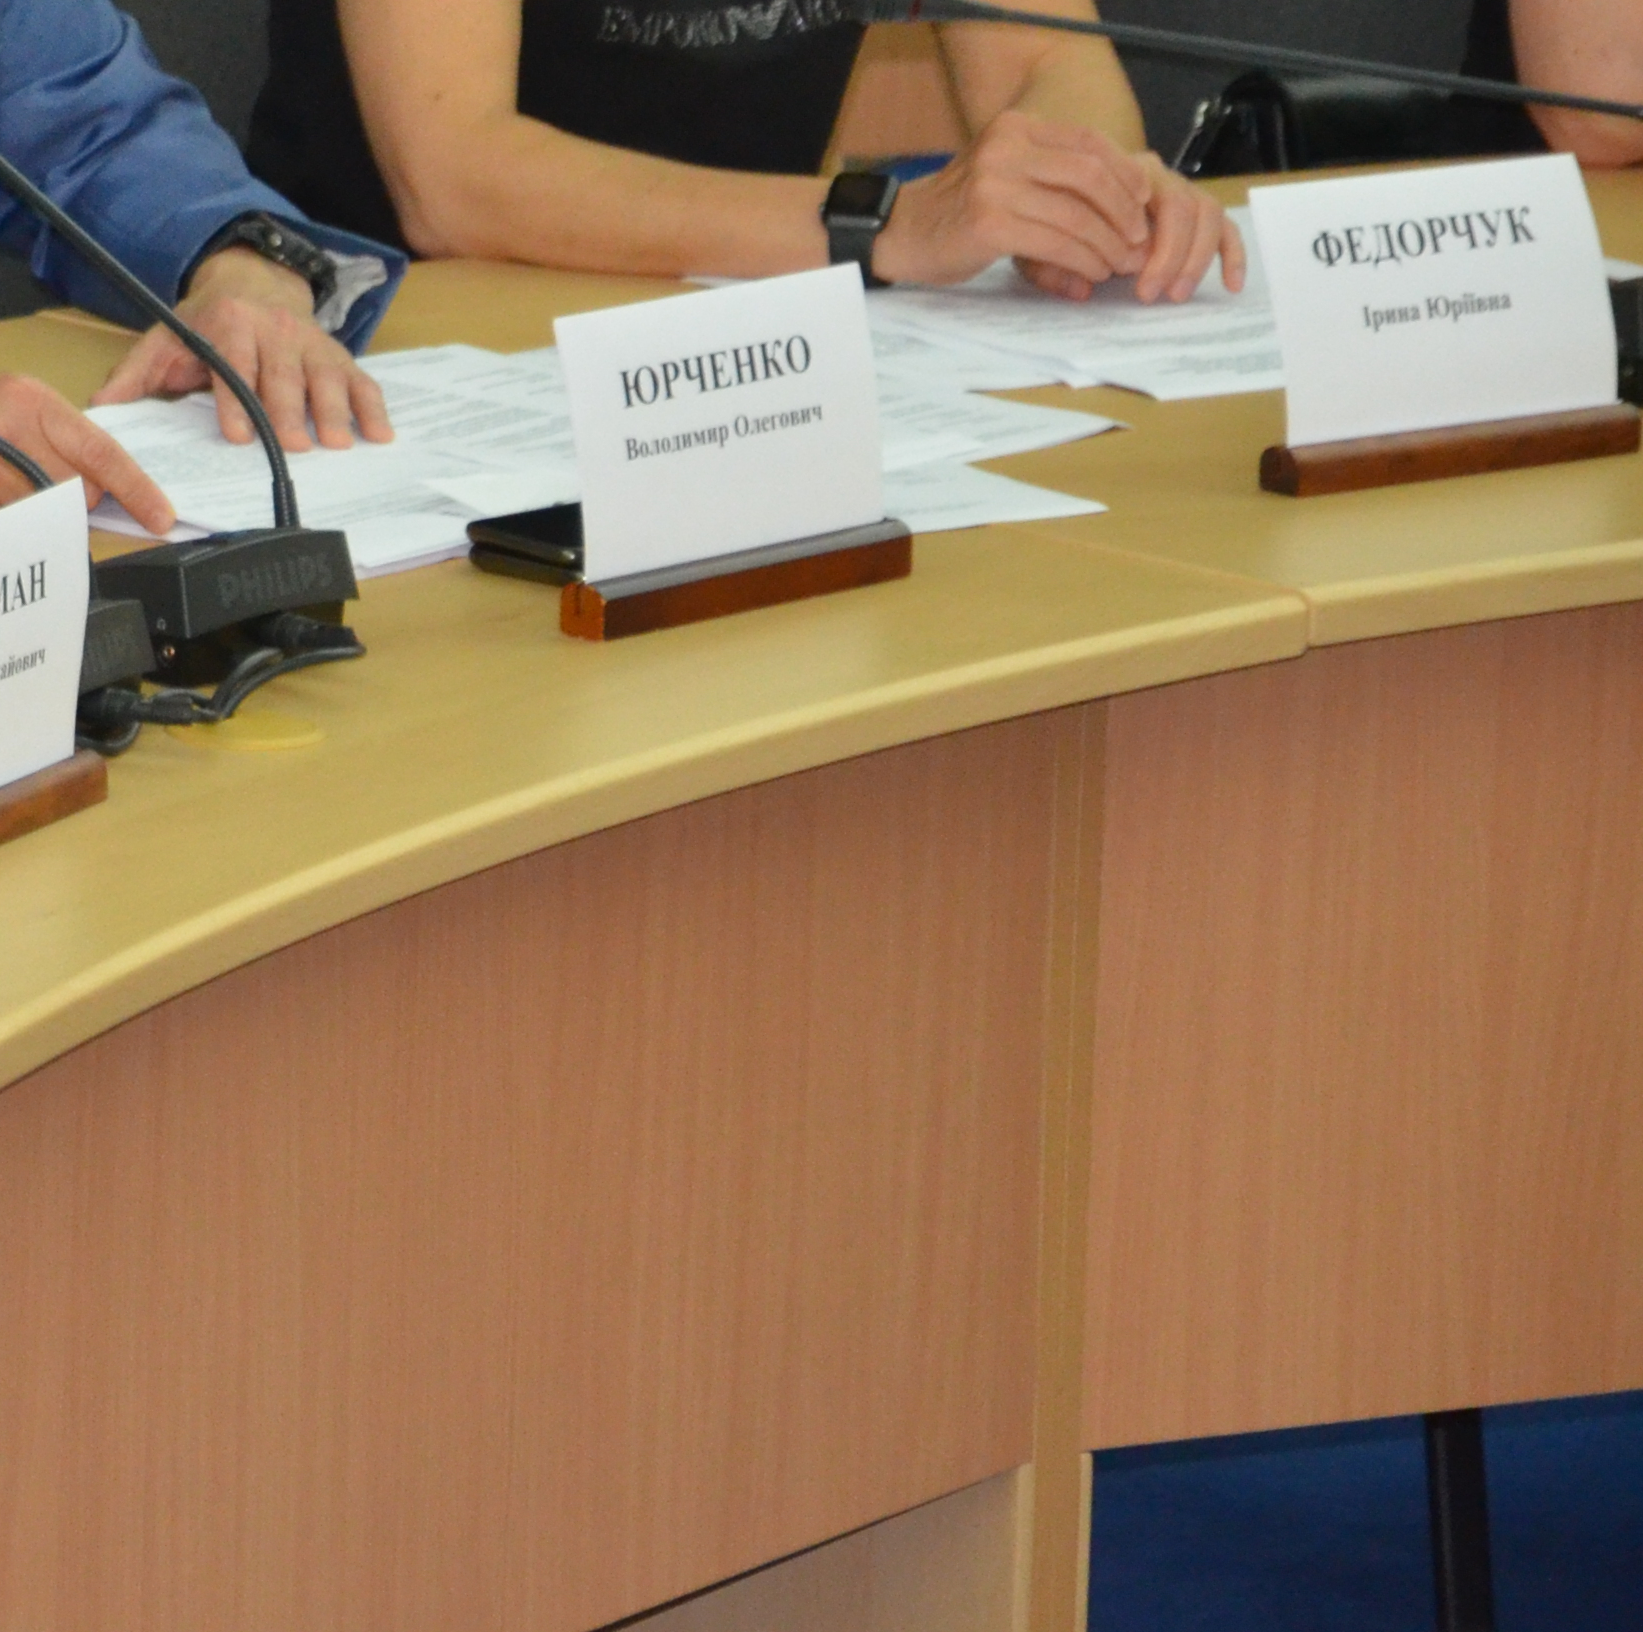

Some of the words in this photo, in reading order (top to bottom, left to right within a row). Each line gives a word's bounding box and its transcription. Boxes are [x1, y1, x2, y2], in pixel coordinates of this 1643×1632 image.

[1311, 205, 1535, 268] ФЕДОРЧУК
[1362, 303, 1421, 333] Ірина
[1425, 292, 1513, 323] Юріївна
[619, 334, 812, 409] ЮРЧЕНКО
[625, 424, 730, 462] Володимир
[733, 405, 823, 438] Олегович
